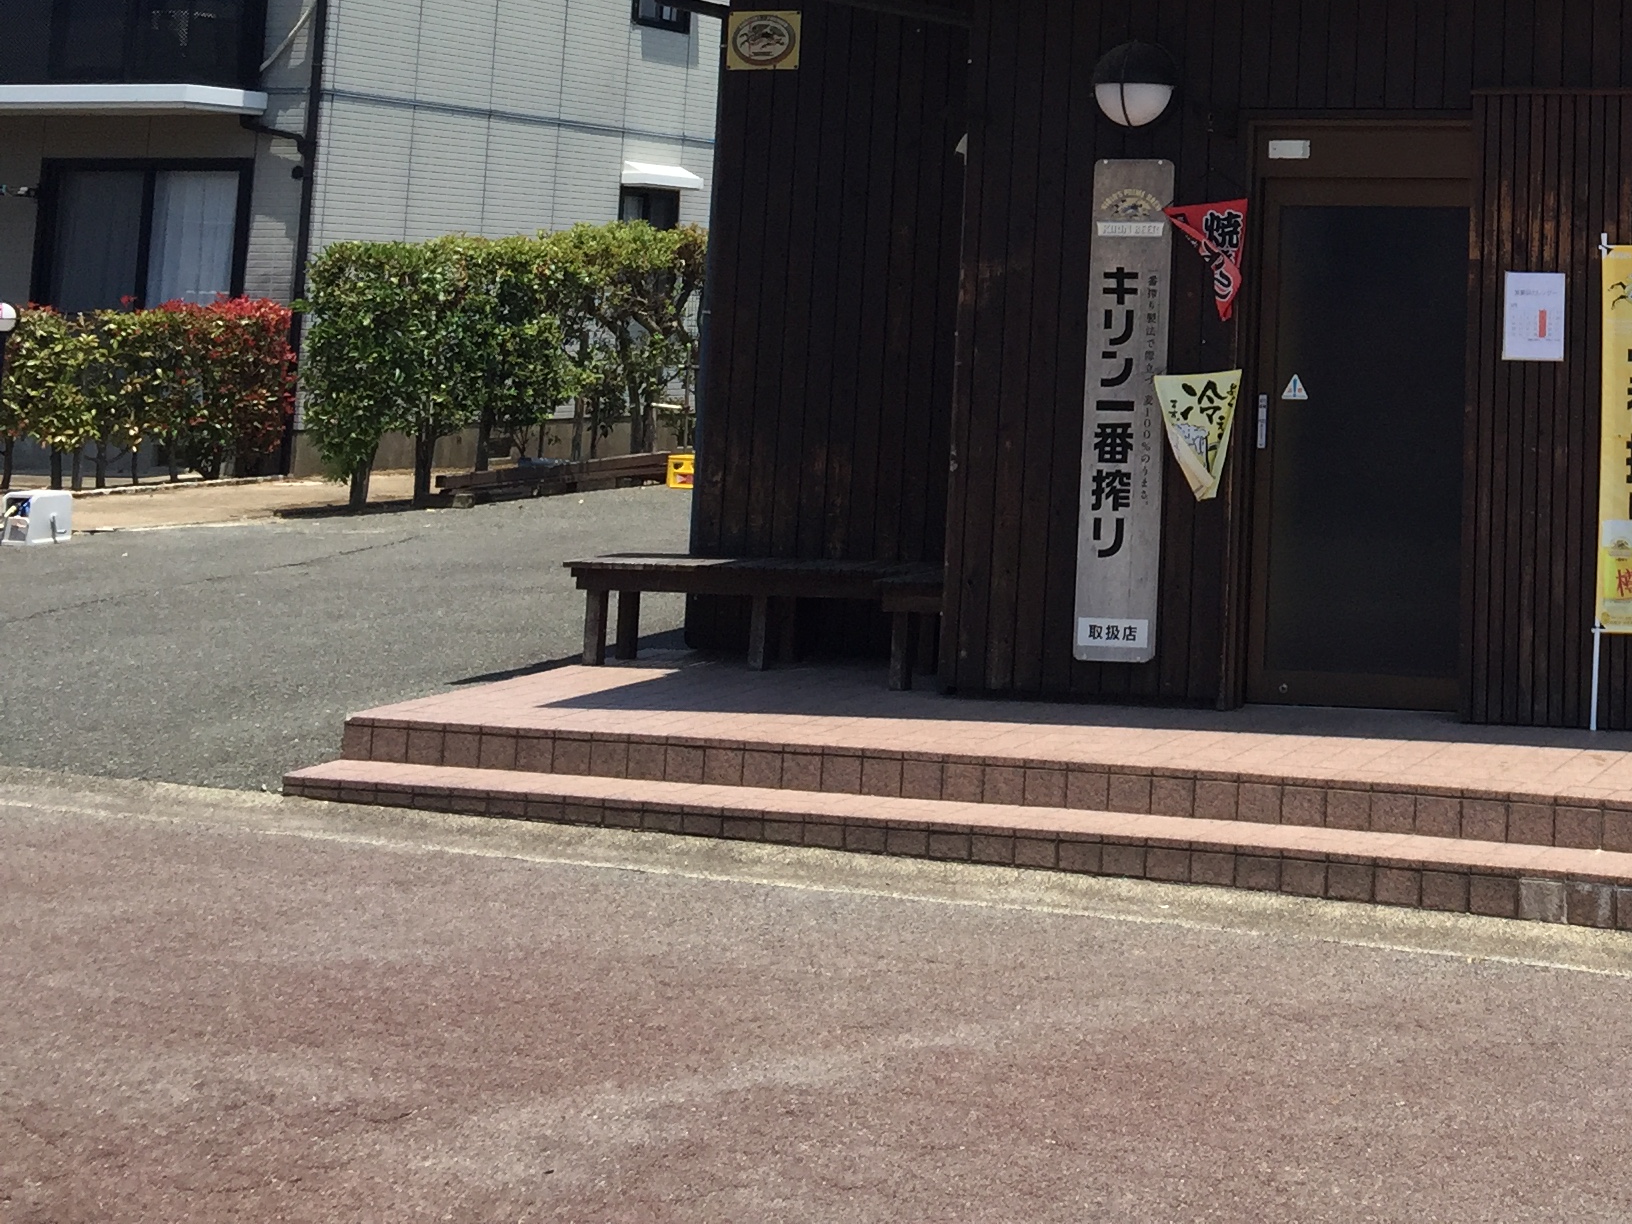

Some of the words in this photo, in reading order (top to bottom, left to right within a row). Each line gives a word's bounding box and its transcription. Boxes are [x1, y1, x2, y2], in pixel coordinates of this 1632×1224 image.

[1091, 266, 1139, 559] キリン一番搾り
[1088, 624, 1138, 642] 取扱店
